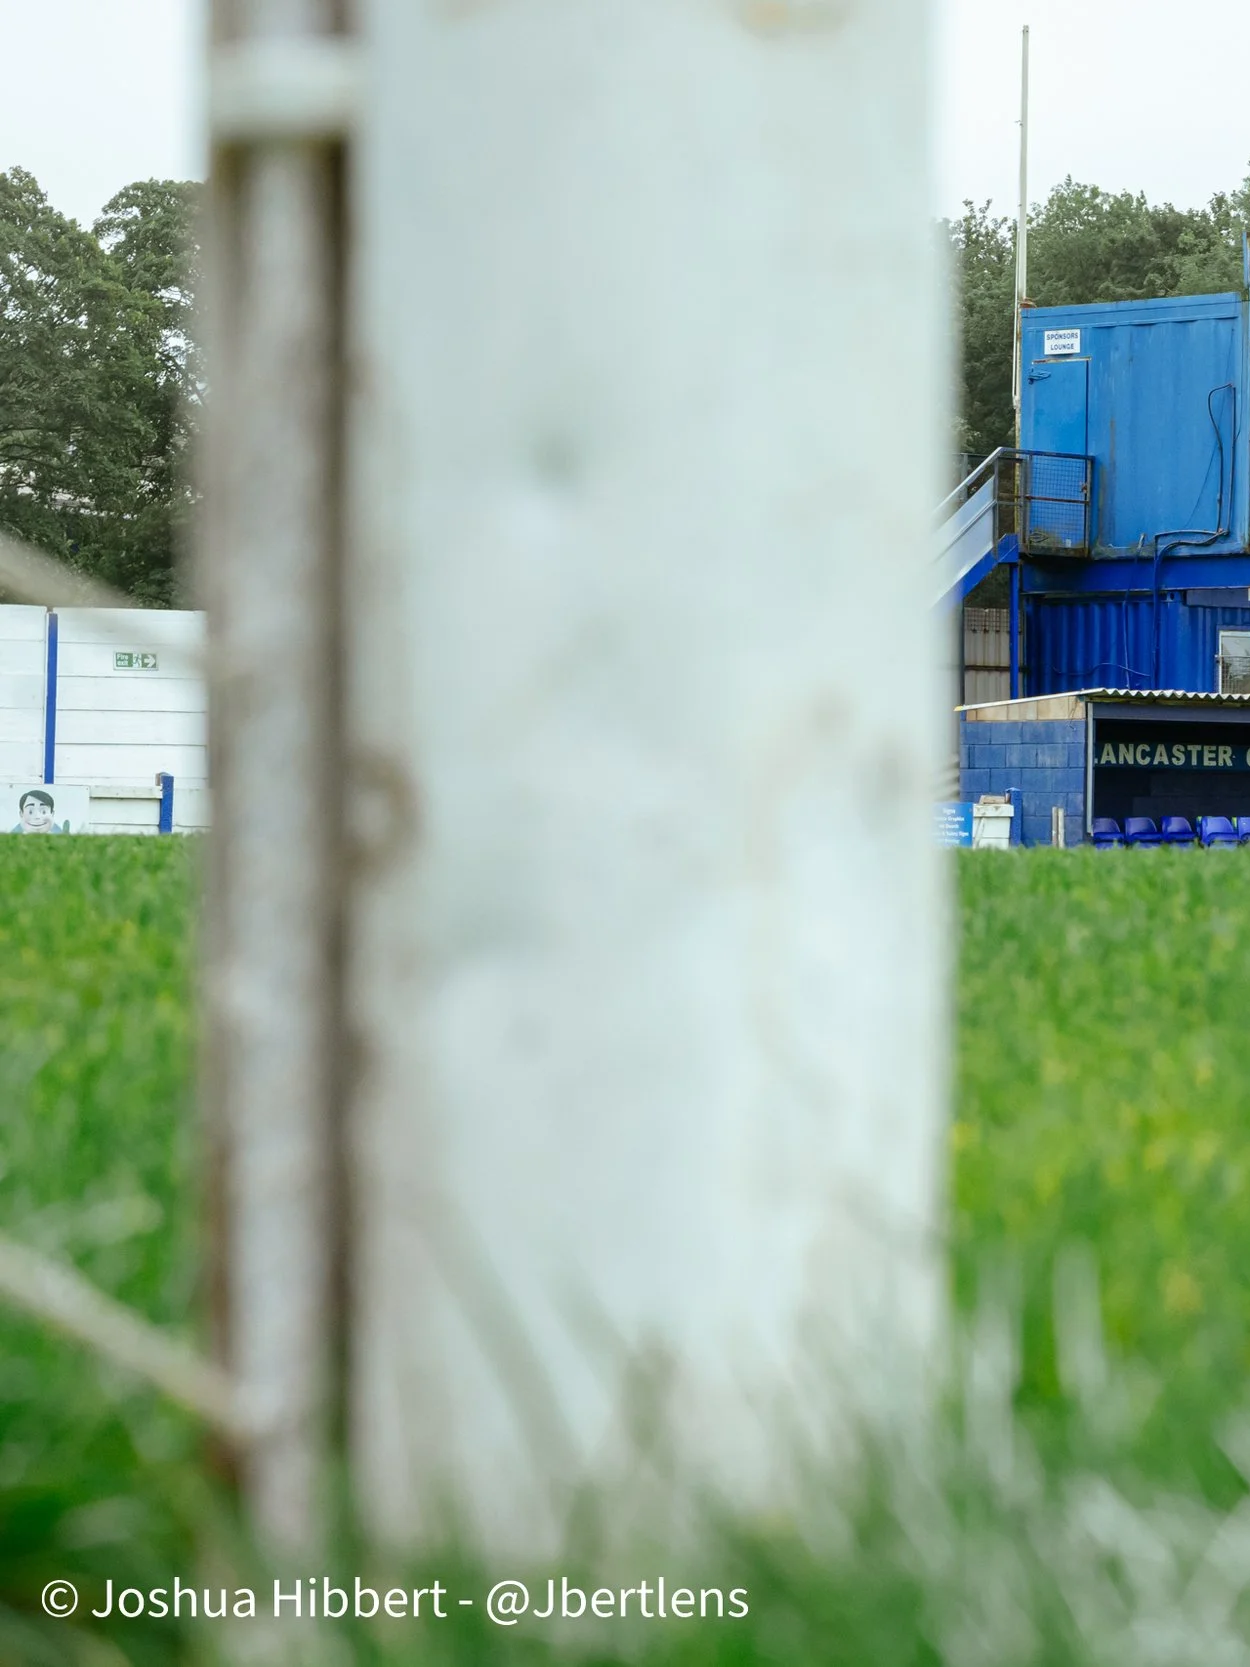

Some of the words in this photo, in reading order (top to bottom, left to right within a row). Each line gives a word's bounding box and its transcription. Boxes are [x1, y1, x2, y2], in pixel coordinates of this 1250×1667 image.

[1046, 332, 1079, 340] SPONSORS
[1050, 343, 1075, 351] LOUNGE
[1094, 743, 1234, 767] ANCASTER
